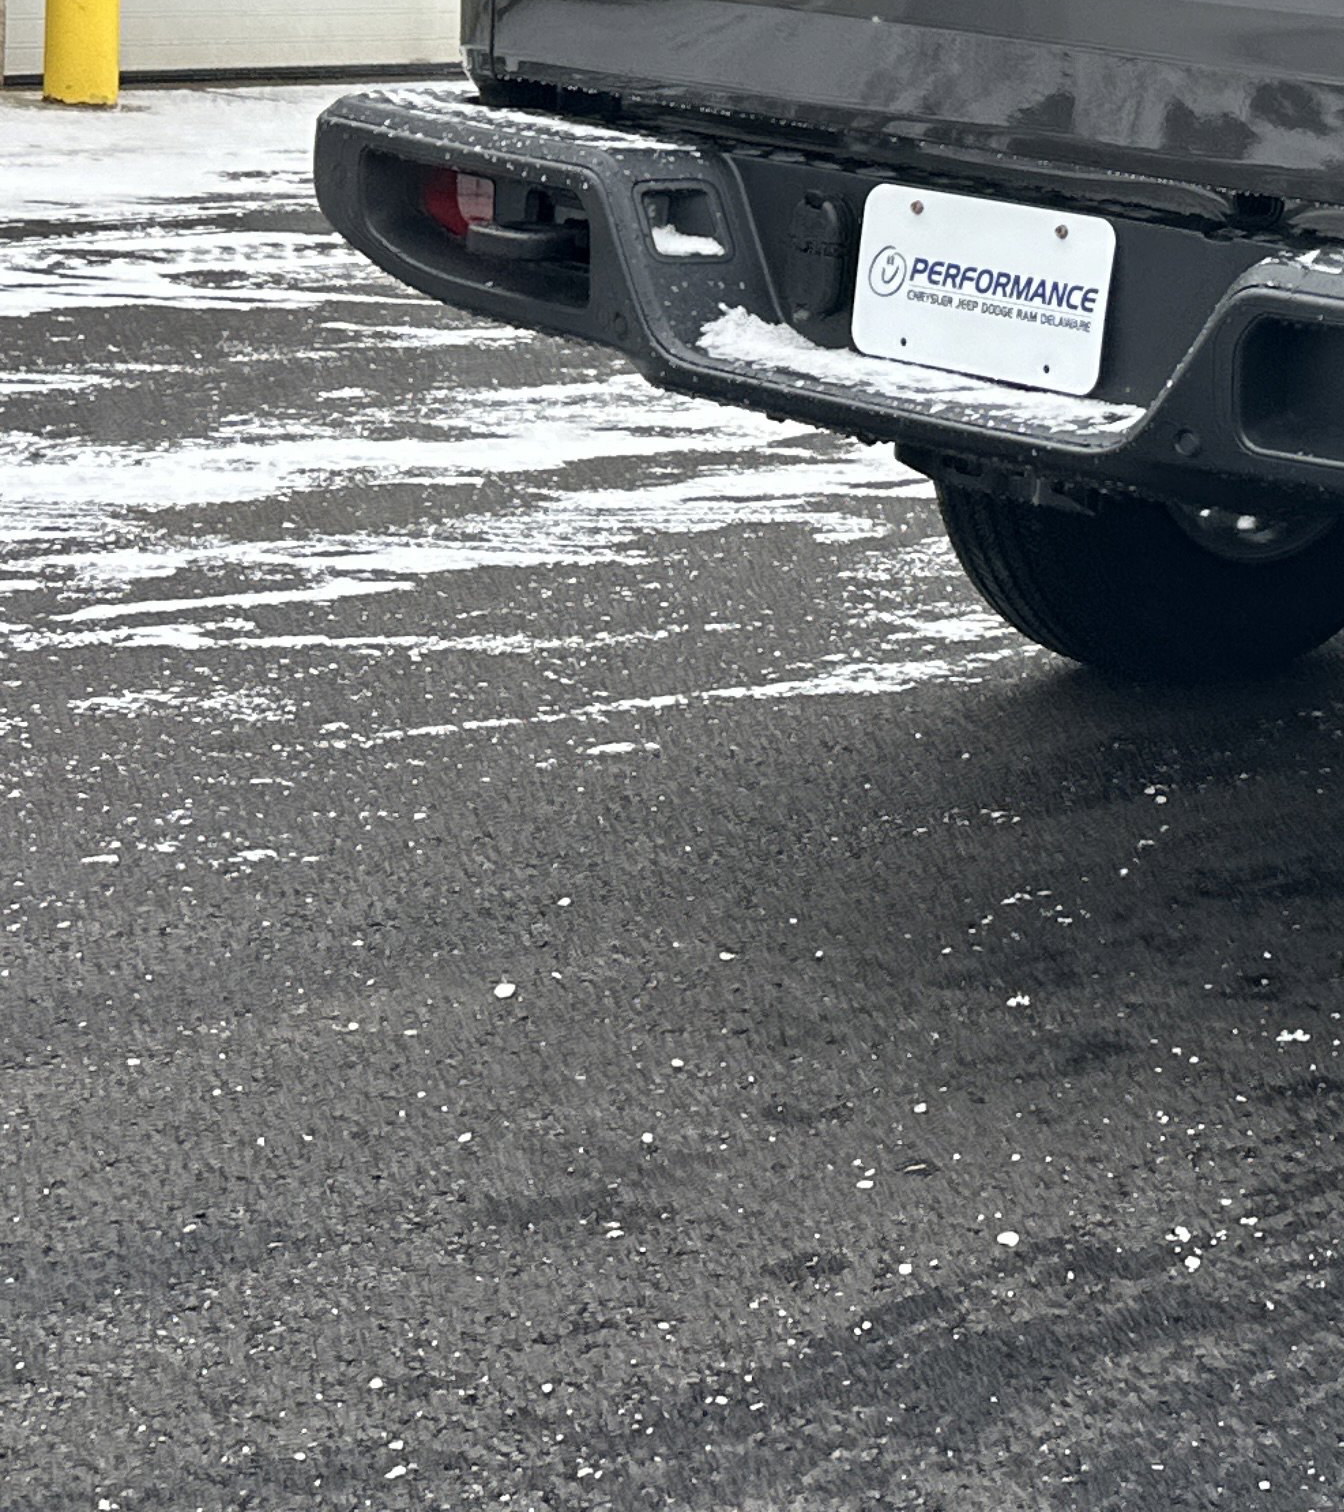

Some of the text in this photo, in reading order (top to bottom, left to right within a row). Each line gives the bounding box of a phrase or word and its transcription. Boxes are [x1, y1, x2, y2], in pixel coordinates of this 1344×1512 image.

[907, 289, 953, 307] CHRYSLER
[956, 300, 979, 311] JEEP
[981, 302, 1013, 319] DODGE
[1016, 309, 1038, 322] RAM
[909, 257, 1099, 313] PERFORMANCE
